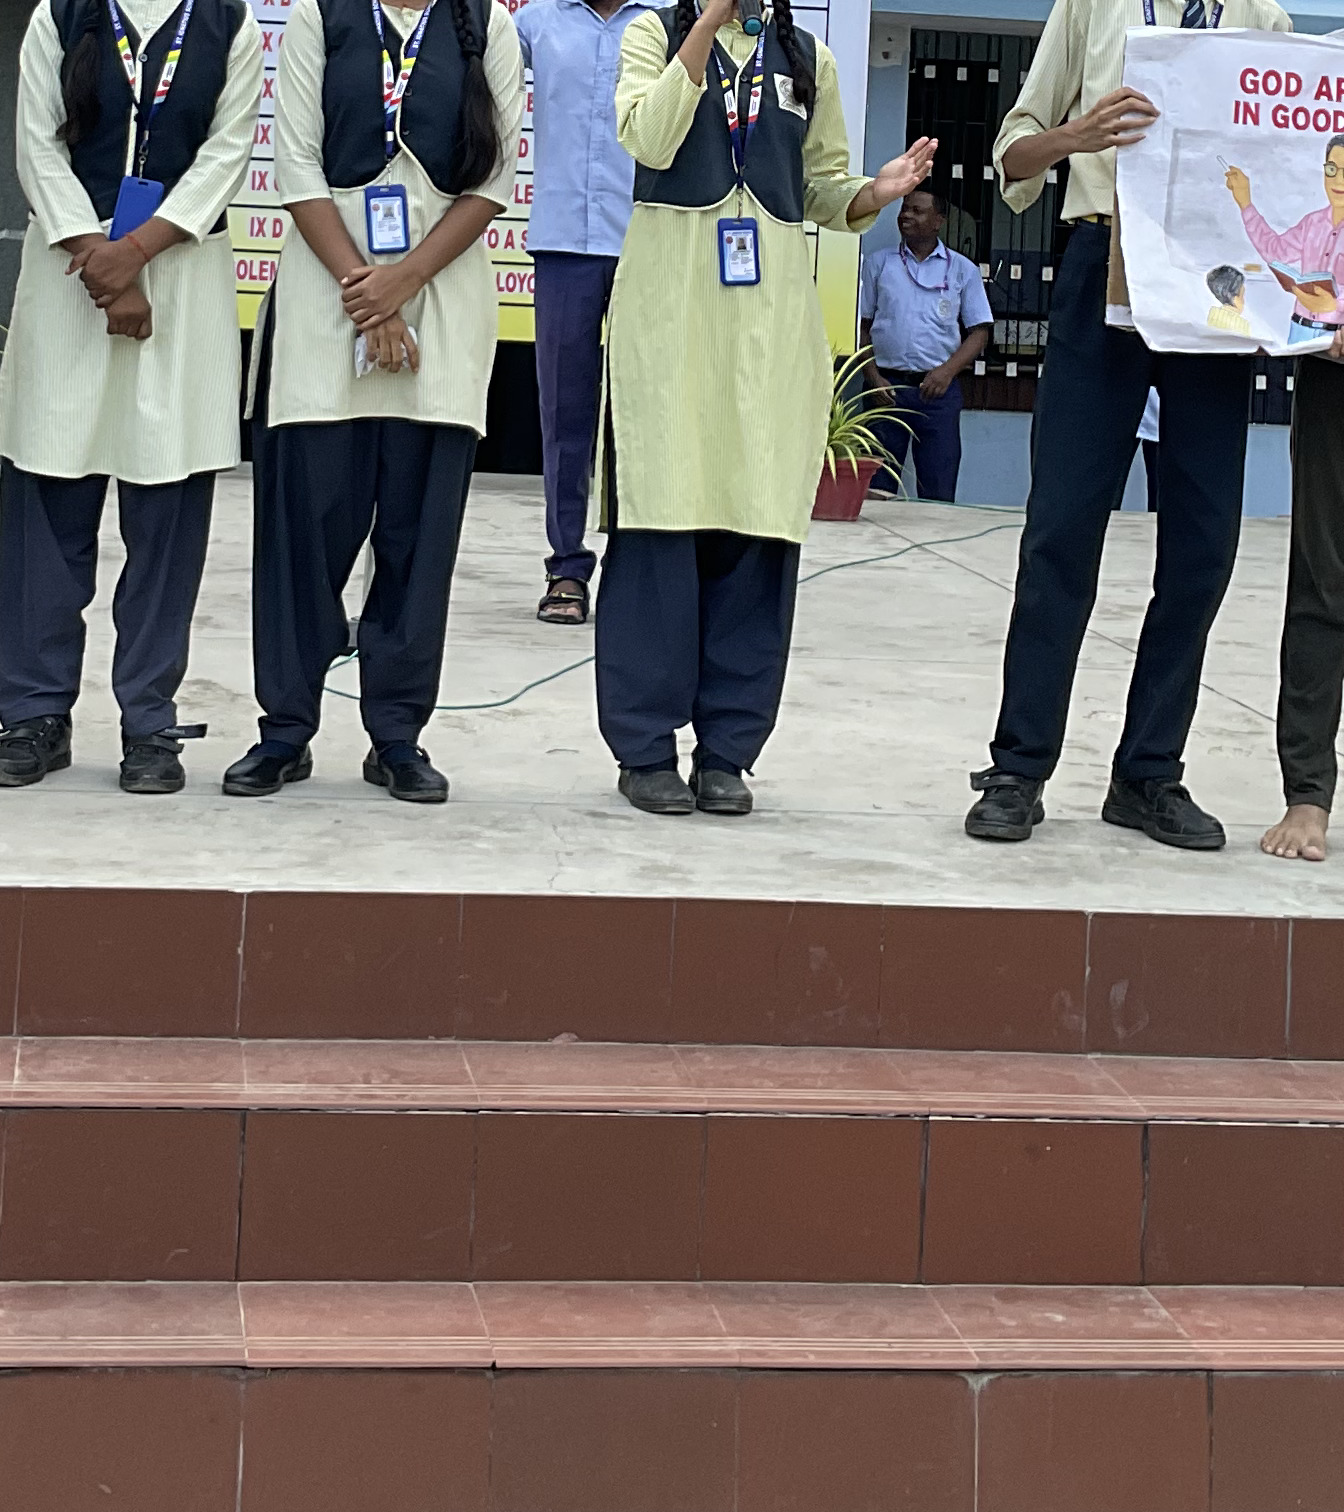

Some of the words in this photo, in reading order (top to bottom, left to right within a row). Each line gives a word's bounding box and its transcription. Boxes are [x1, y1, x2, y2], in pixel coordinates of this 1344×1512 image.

[1239, 67, 1304, 98] GOD
[1232, 100, 1261, 126] IN
[249, 217, 266, 237] IX
[272, 218, 283, 238] D
